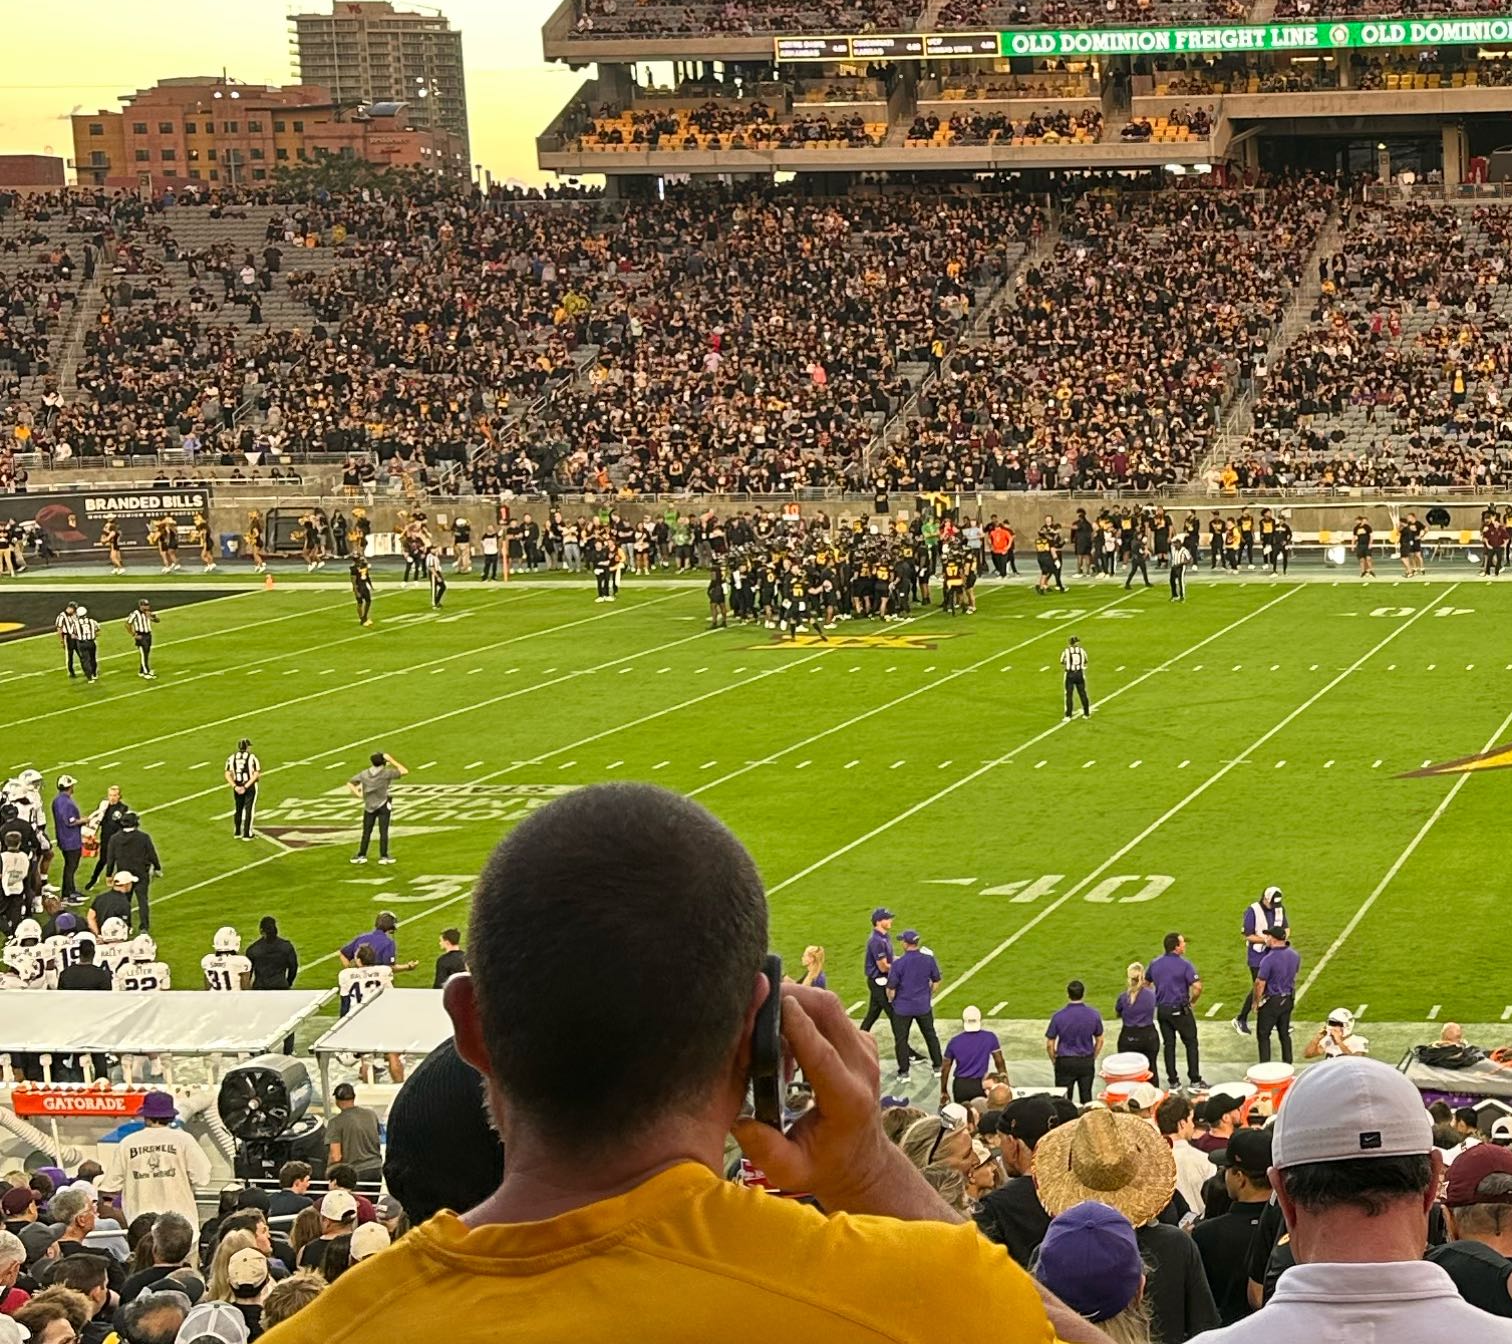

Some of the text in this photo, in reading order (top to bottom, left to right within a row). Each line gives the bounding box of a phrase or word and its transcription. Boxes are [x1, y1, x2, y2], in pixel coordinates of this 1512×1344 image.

[1012, 27, 1318, 54] OLD DOMINION FREIGHT LINE
[1361, 24, 1404, 44] OLD
[85, 494, 203, 511] BRANDED BILLS
[1368, 606, 1475, 617] 40
[279, 797, 552, 809] AMERCA
[979, 874, 1176, 904] 40
[207, 970, 232, 991] 31
[43, 1096, 126, 1111] GATORADE
